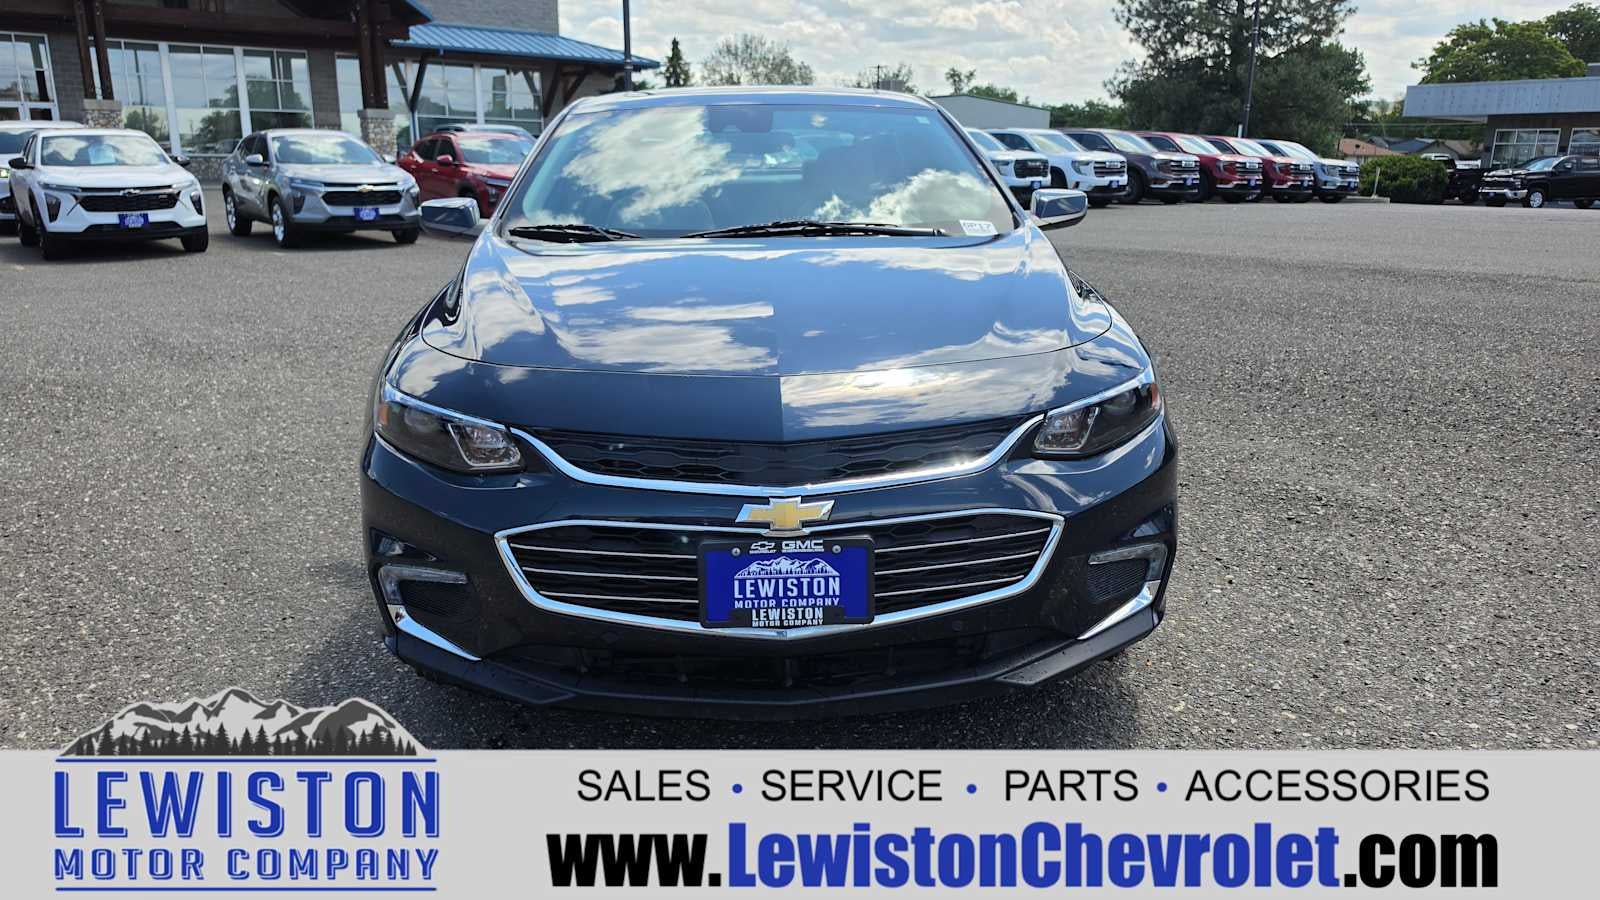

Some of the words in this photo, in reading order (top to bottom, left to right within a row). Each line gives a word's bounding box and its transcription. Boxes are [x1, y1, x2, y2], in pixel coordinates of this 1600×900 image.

[782, 540, 823, 549] GMC
[734, 577, 840, 598] LEWISTON
[735, 600, 776, 609] MOTOR
[782, 598, 840, 607] COMPANY
[752, 608, 823, 620] LEWISTON
[783, 619, 824, 627] COMPANY
